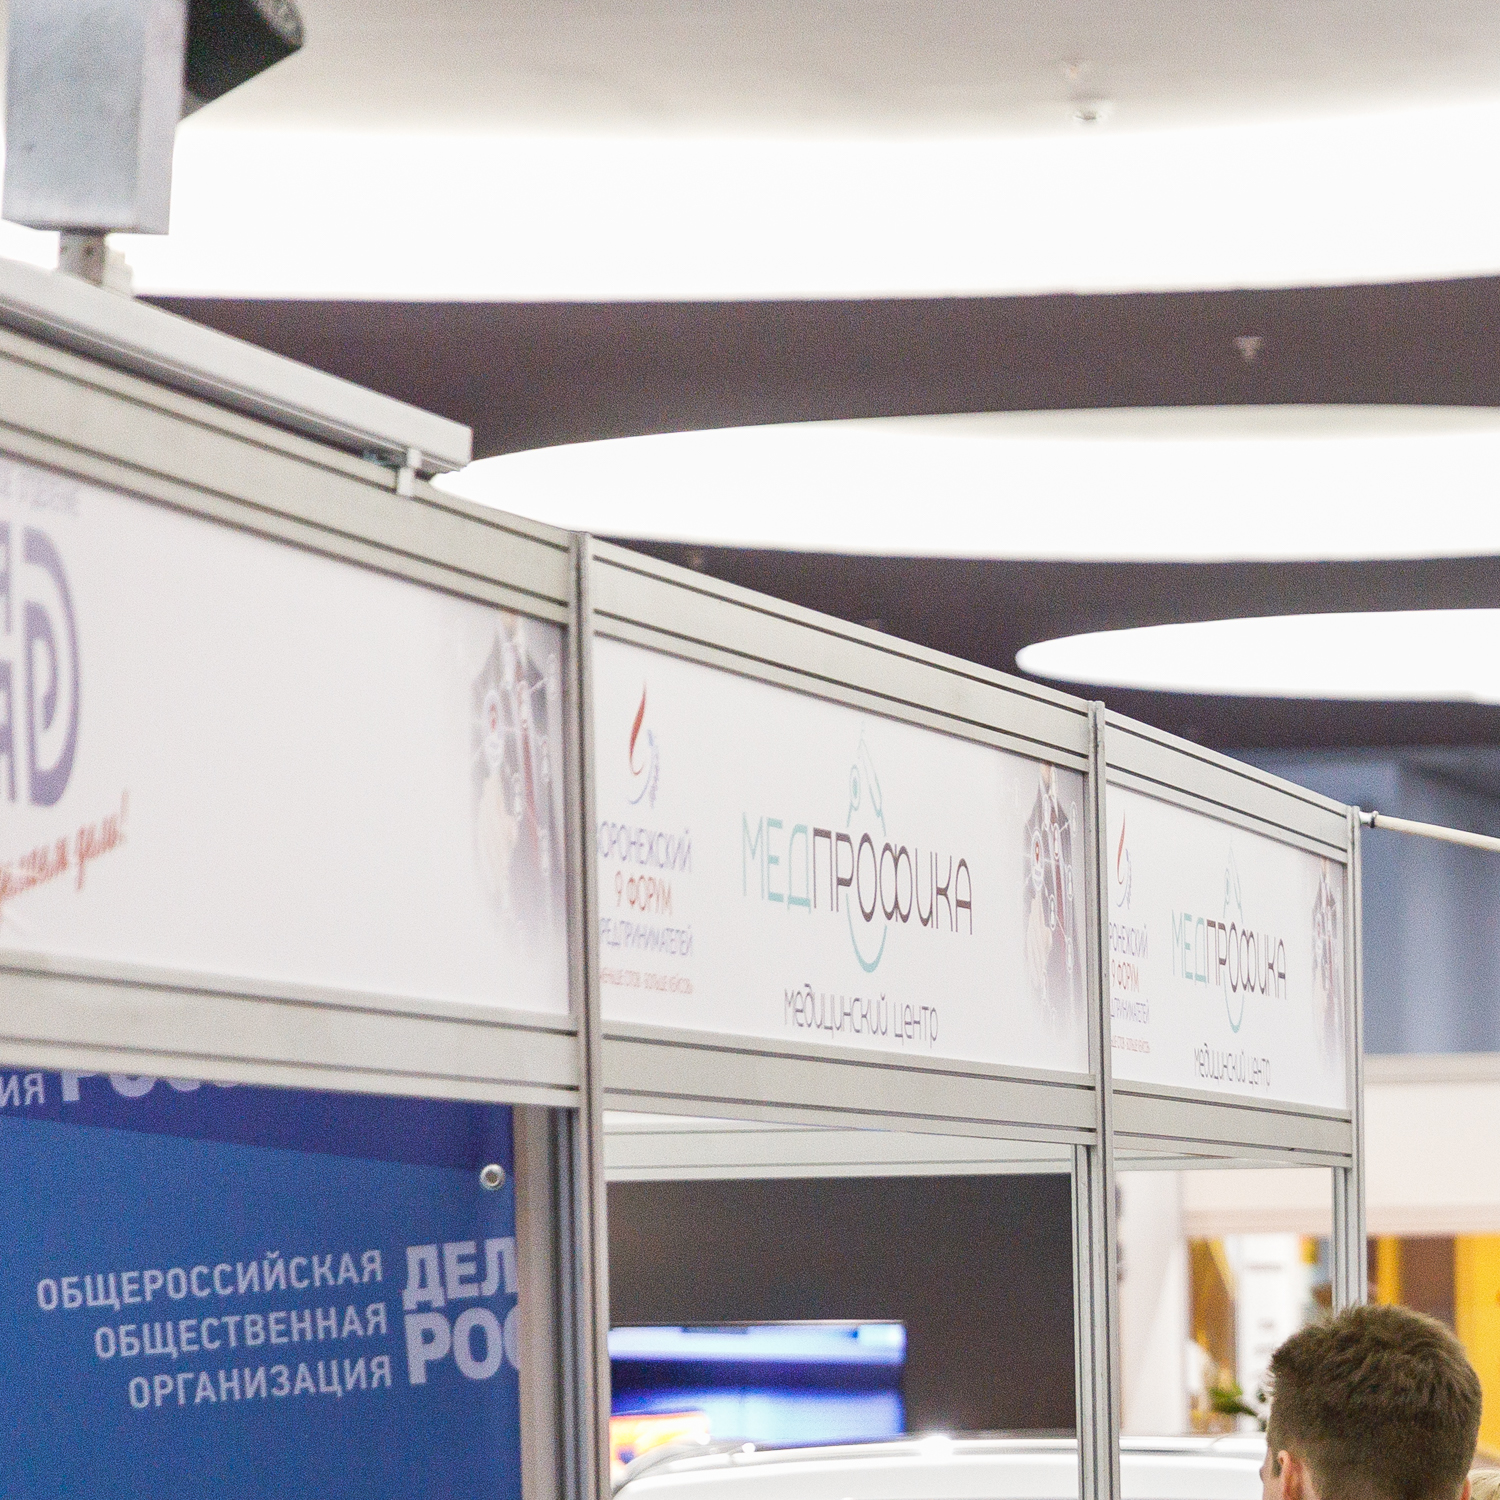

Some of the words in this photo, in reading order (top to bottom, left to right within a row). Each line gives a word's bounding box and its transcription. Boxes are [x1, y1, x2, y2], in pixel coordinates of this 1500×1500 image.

[597, 820, 693, 873] ОРОНЕЖСКИЙ
[614, 870, 623, 907] 9
[627, 873, 673, 916] ФОРУМ
[742, 812, 974, 936] МЕДПРОФИКА
[600, 917, 694, 957] РЕДПРИНИМАТЕЛЕЙ
[1109, 922, 1149, 959] РОНЕЖСКИЙ
[1171, 910, 1288, 1000] МЕДПРОФИКА
[1117, 961, 1141, 993] ФОРУМ
[784, 983, 888, 1039] медицинский
[894, 1003, 940, 1048] центр
[1248, 1056, 1272, 1092] центр
[36, 1250, 384, 1312] ОБЩЕРОССИЙСКАЯ
[402, 1236, 518, 1311] ДЕЛ
[94, 1302, 388, 1360] ОБЩЕСТВЕННАЯ
[127, 1355, 393, 1409] ОРГАНИЗАЦИЯ
